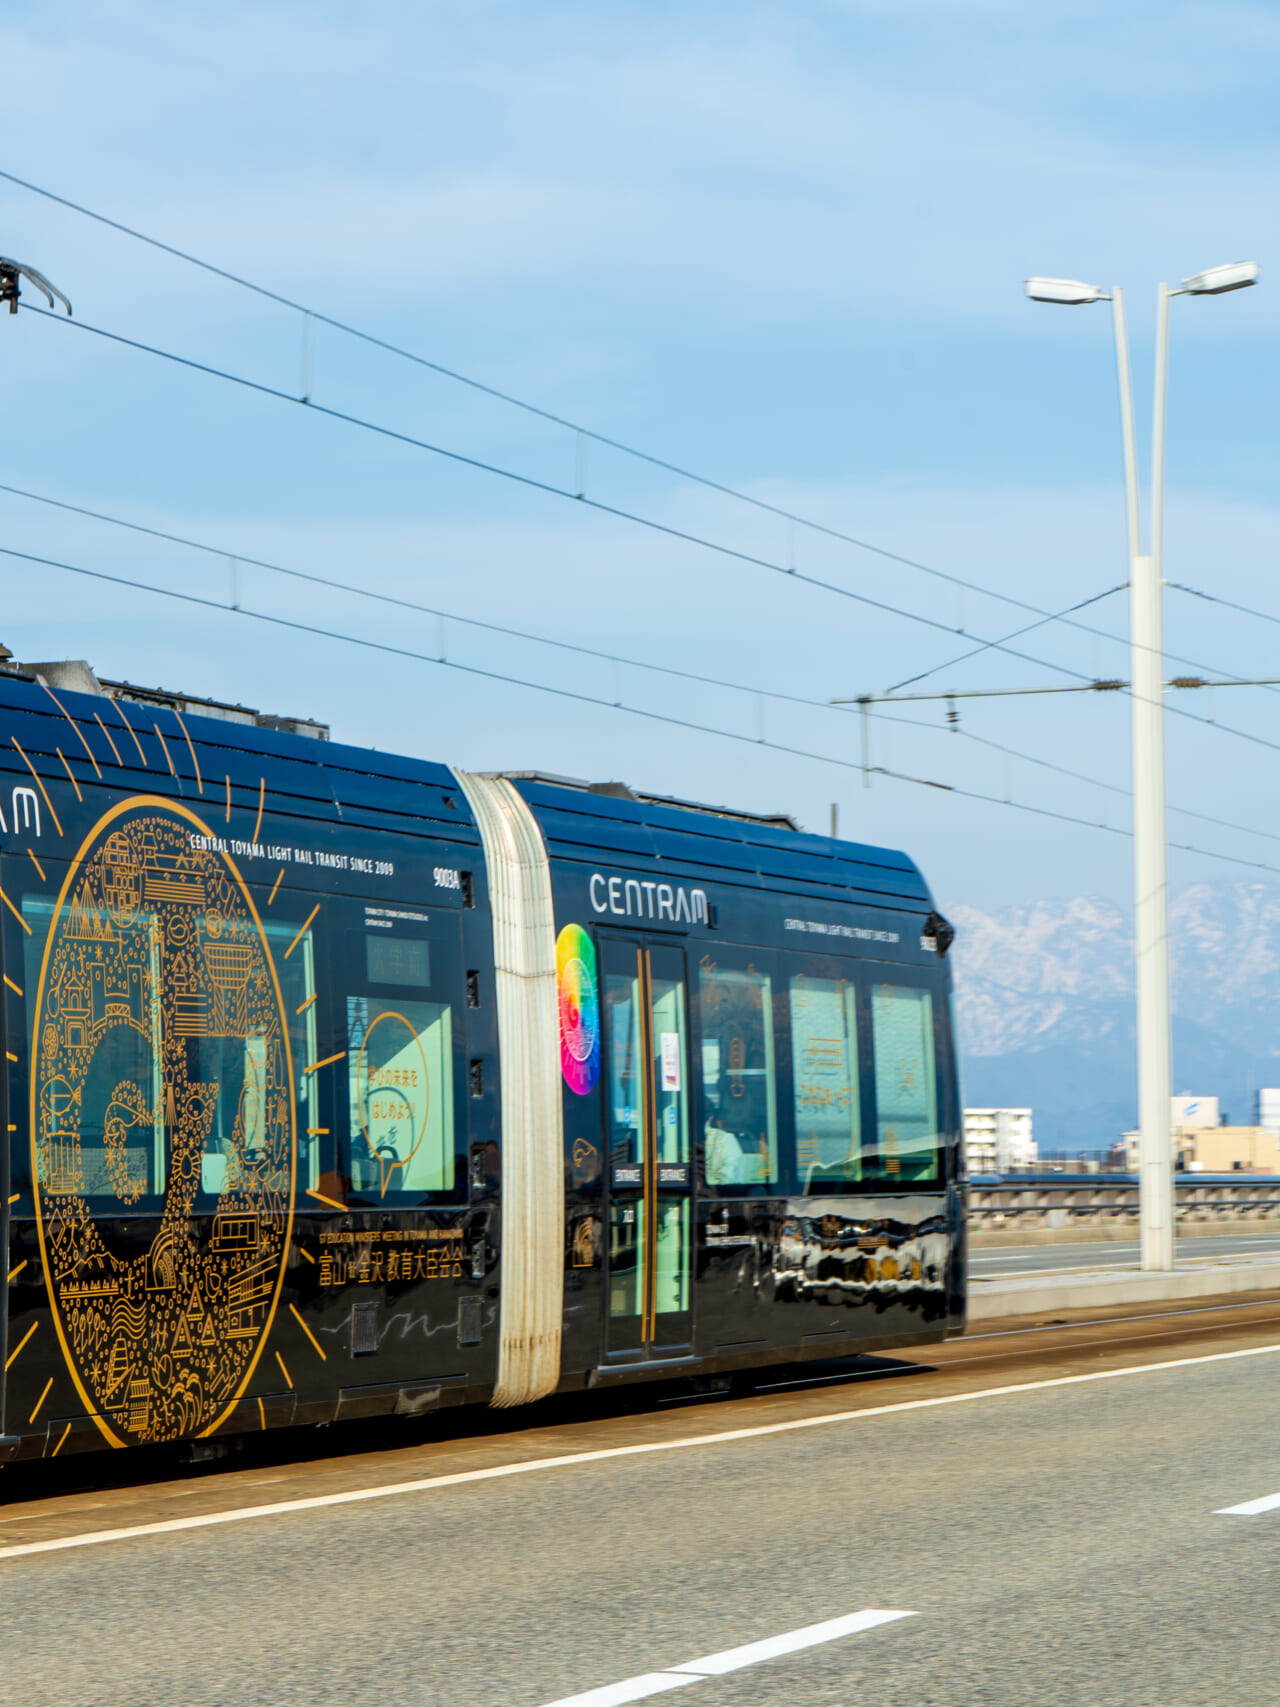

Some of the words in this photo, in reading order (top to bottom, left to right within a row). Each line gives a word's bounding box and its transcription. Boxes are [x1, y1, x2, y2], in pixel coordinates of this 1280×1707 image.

[190, 833, 229, 853] CENTRAL
[230, 839, 265, 858] TOYAMA
[267, 844, 292, 862] LIGHT
[294, 847, 315, 865] RAIL
[315, 851, 349, 870] TRANSIT
[349, 856, 374, 874] SINCE
[375, 860, 394, 876] 2009
[433, 866, 461, 890] 9003A
[589, 873, 709, 925] CENTRAM
